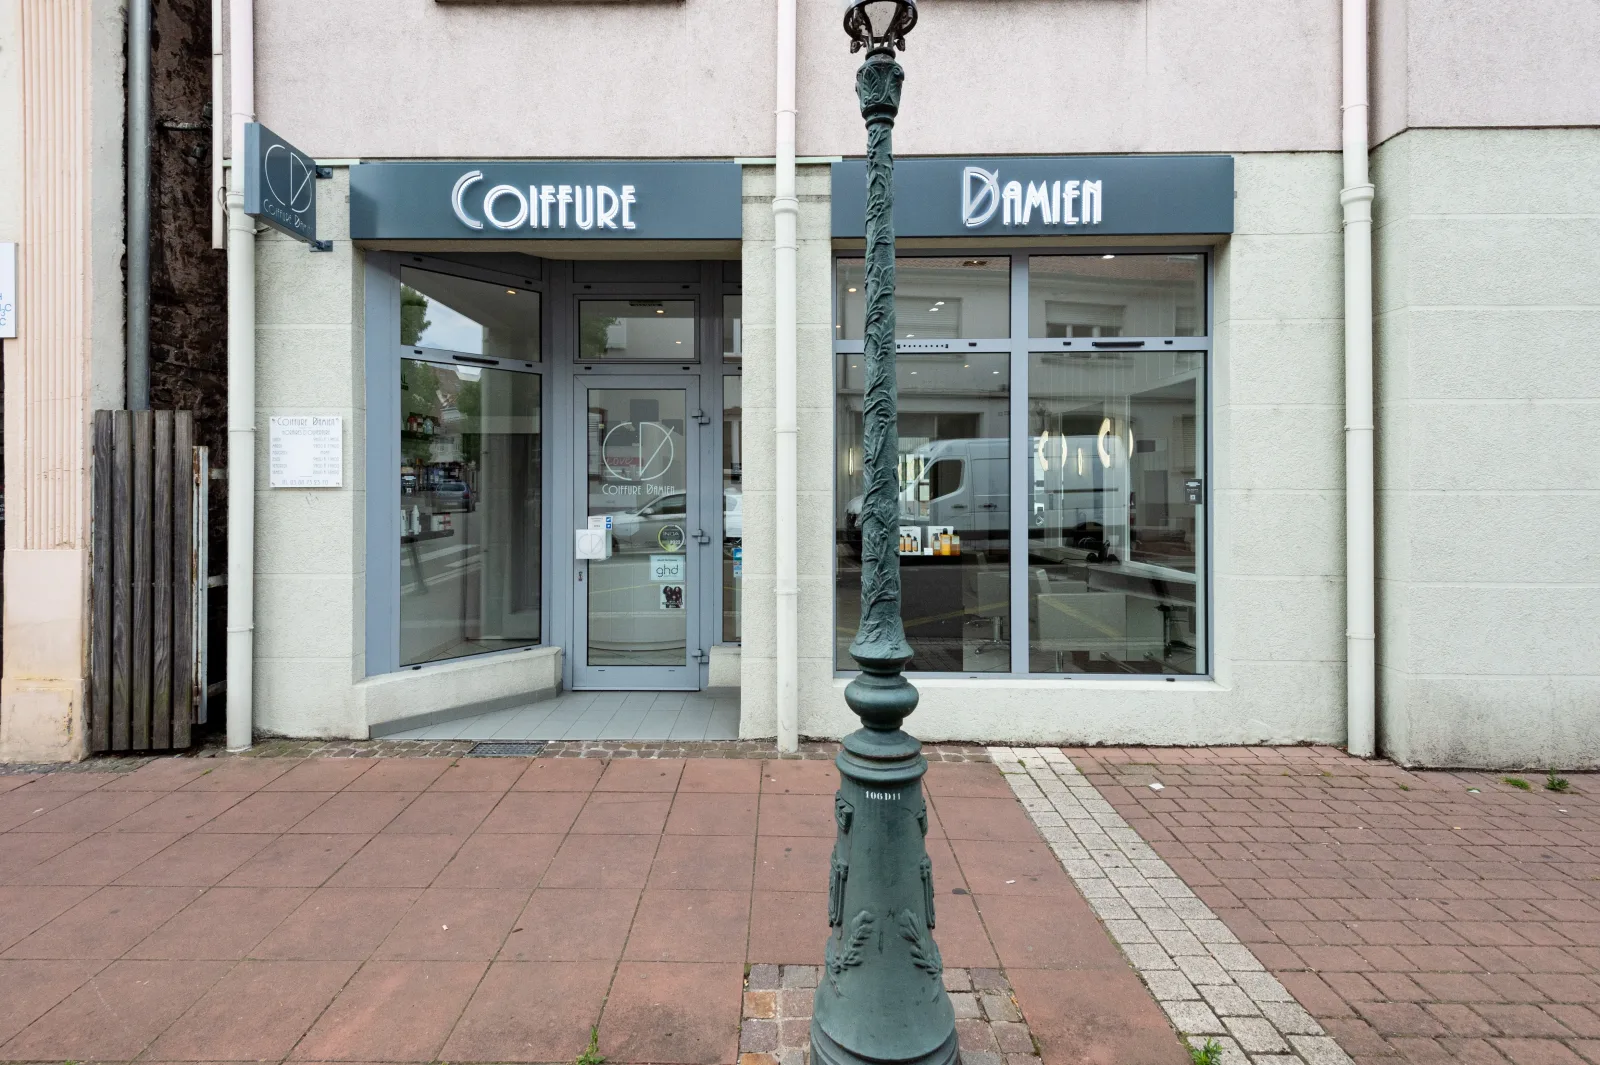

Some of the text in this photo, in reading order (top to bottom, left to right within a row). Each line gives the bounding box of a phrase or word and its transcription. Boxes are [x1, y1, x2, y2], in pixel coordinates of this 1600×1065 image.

[451, 170, 637, 230] COIFFURE
[962, 166, 1102, 227] DAMIEN
[277, 417, 335, 426] COIFFURE DAMIEN
[602, 483, 675, 496] COIFFURE DAMIEN
[656, 564, 679, 578] ghd
